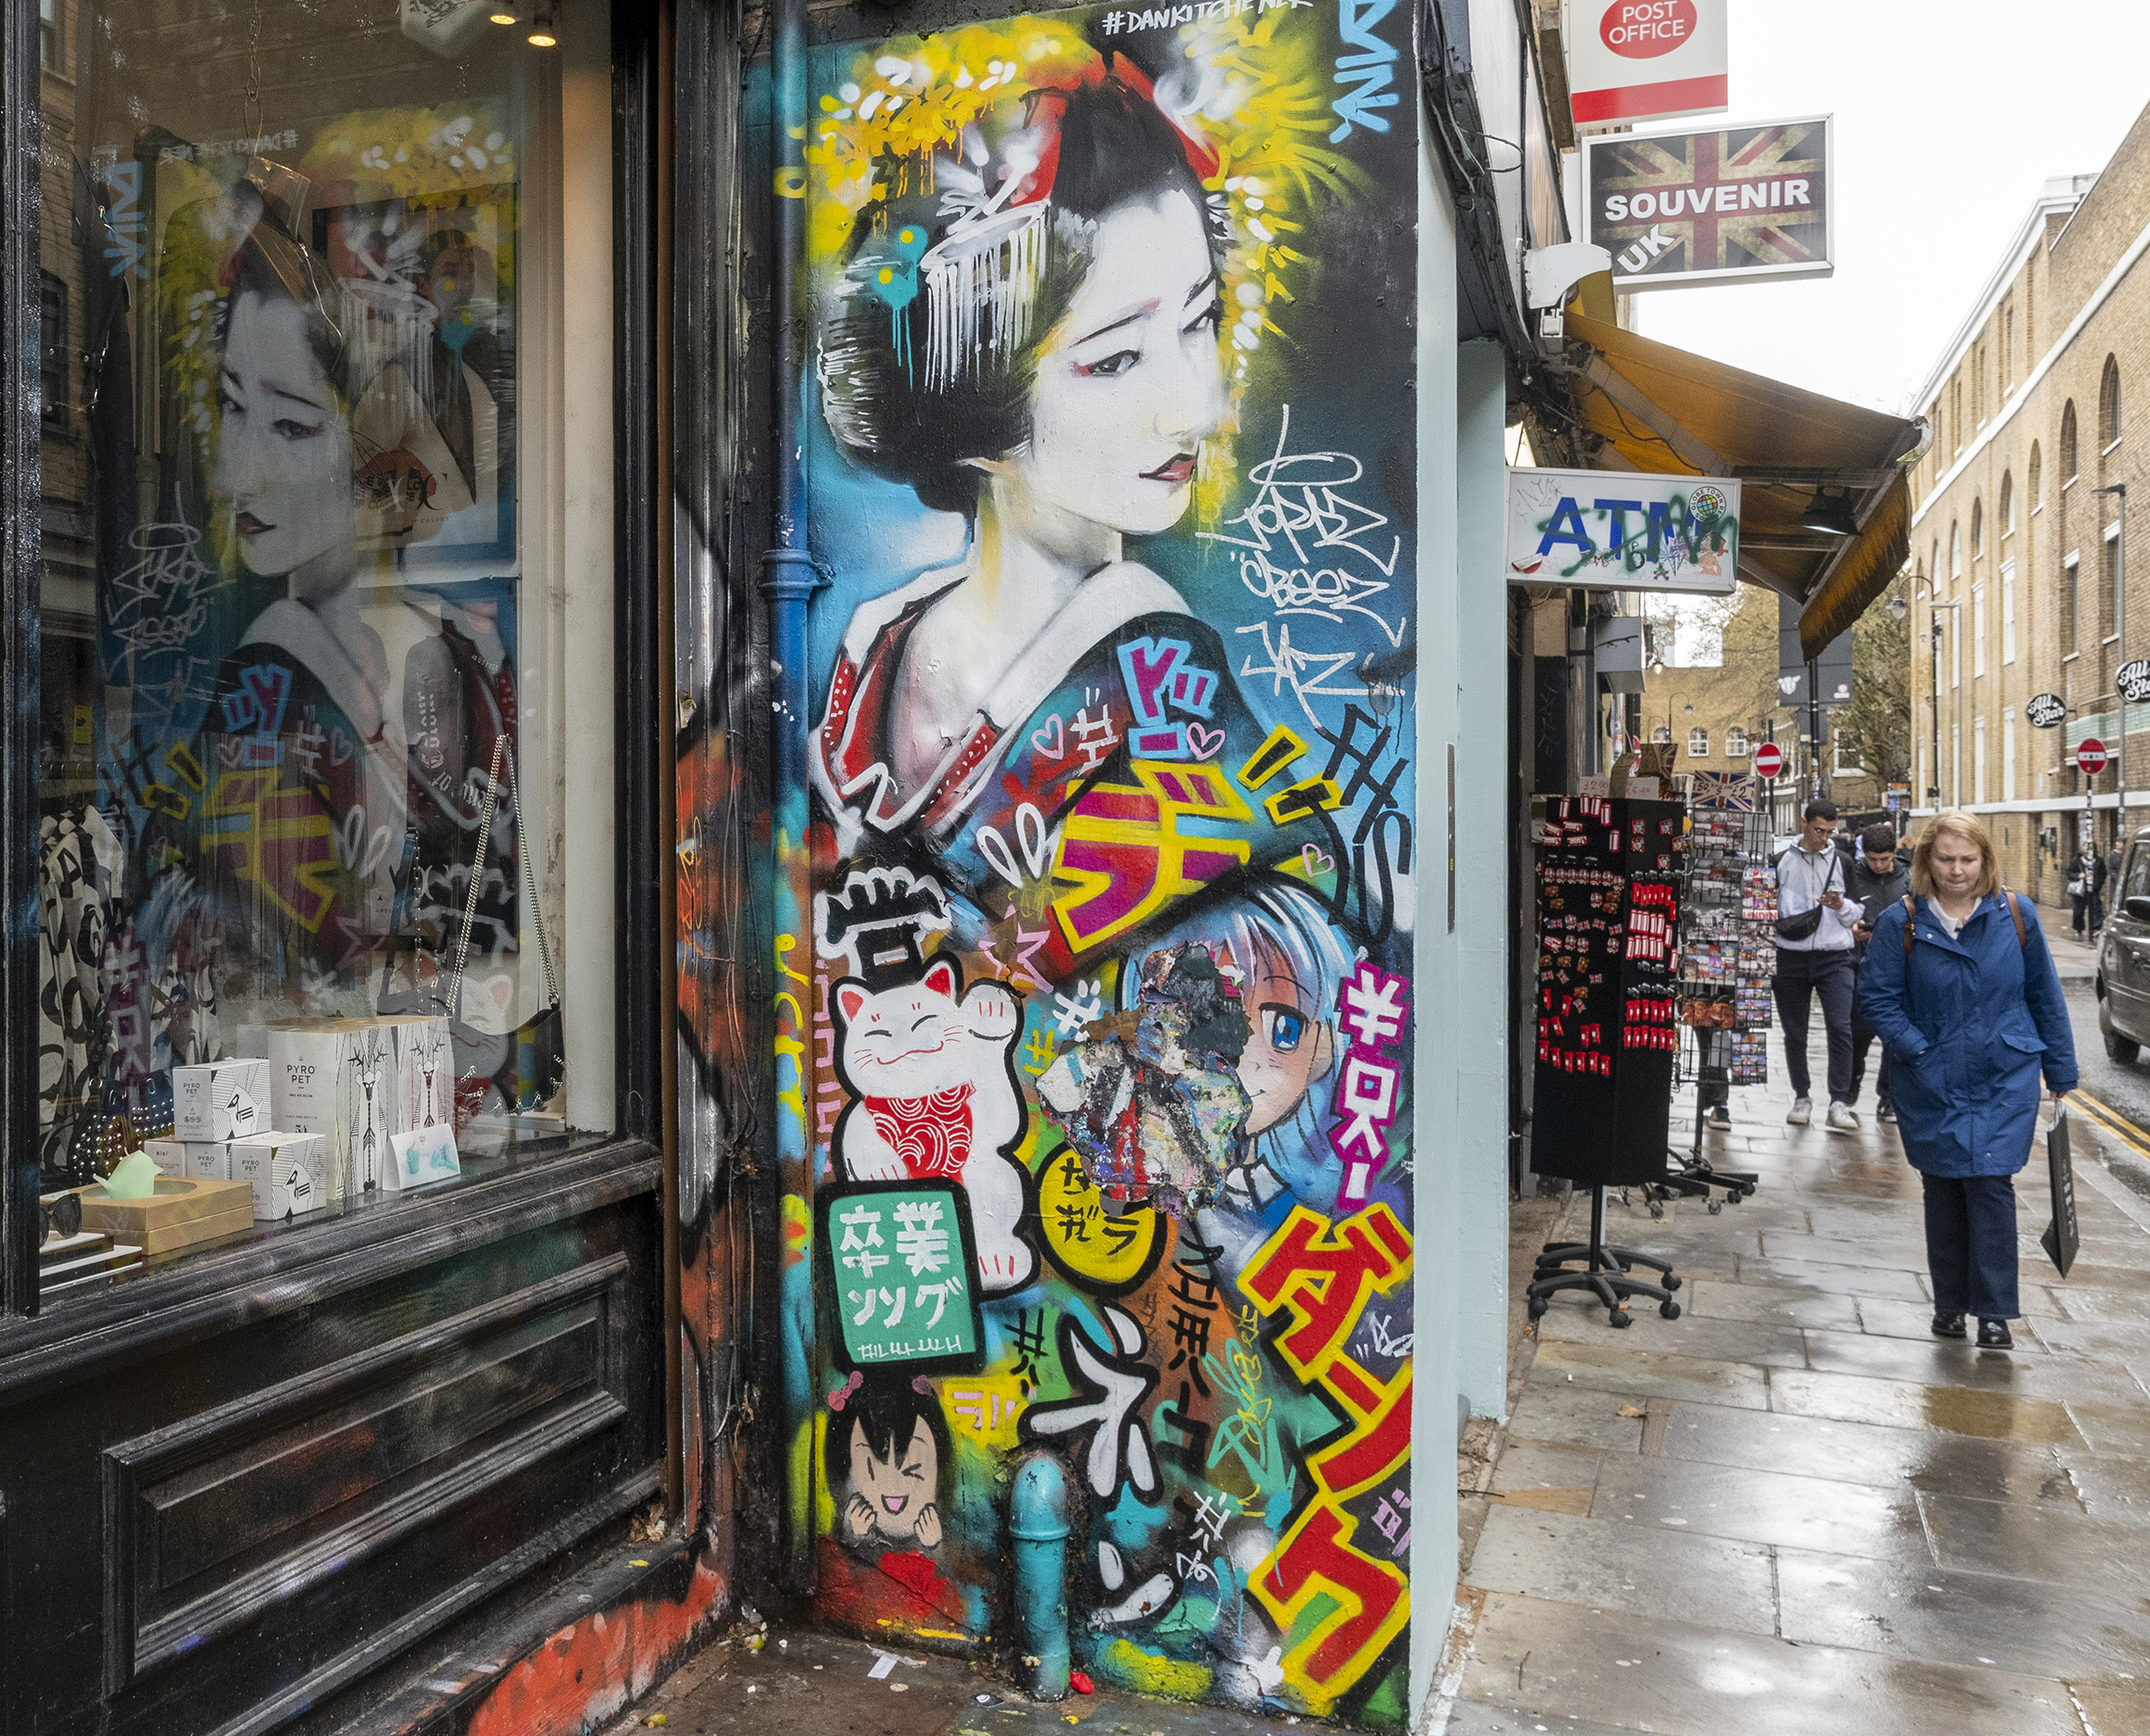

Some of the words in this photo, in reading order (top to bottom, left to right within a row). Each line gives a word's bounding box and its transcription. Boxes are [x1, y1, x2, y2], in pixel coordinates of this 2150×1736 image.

[1621, 0, 1678, 23] POST
[1608, 19, 1685, 45] OFFICE
[1605, 179, 1811, 221] SOUVENIR
[1617, 223, 1675, 274] UK
[1690, 489, 1705, 511] GLOBE
[1707, 487, 1724, 504] TOWN
[1535, 496, 1701, 563] ATM
[2118, 659, 2148, 687] All
[2027, 694, 2053, 715] All
[2032, 706, 2065, 727] Star
[286, 1064, 316, 1075] PYRO
[291, 1075, 311, 1084] PET
